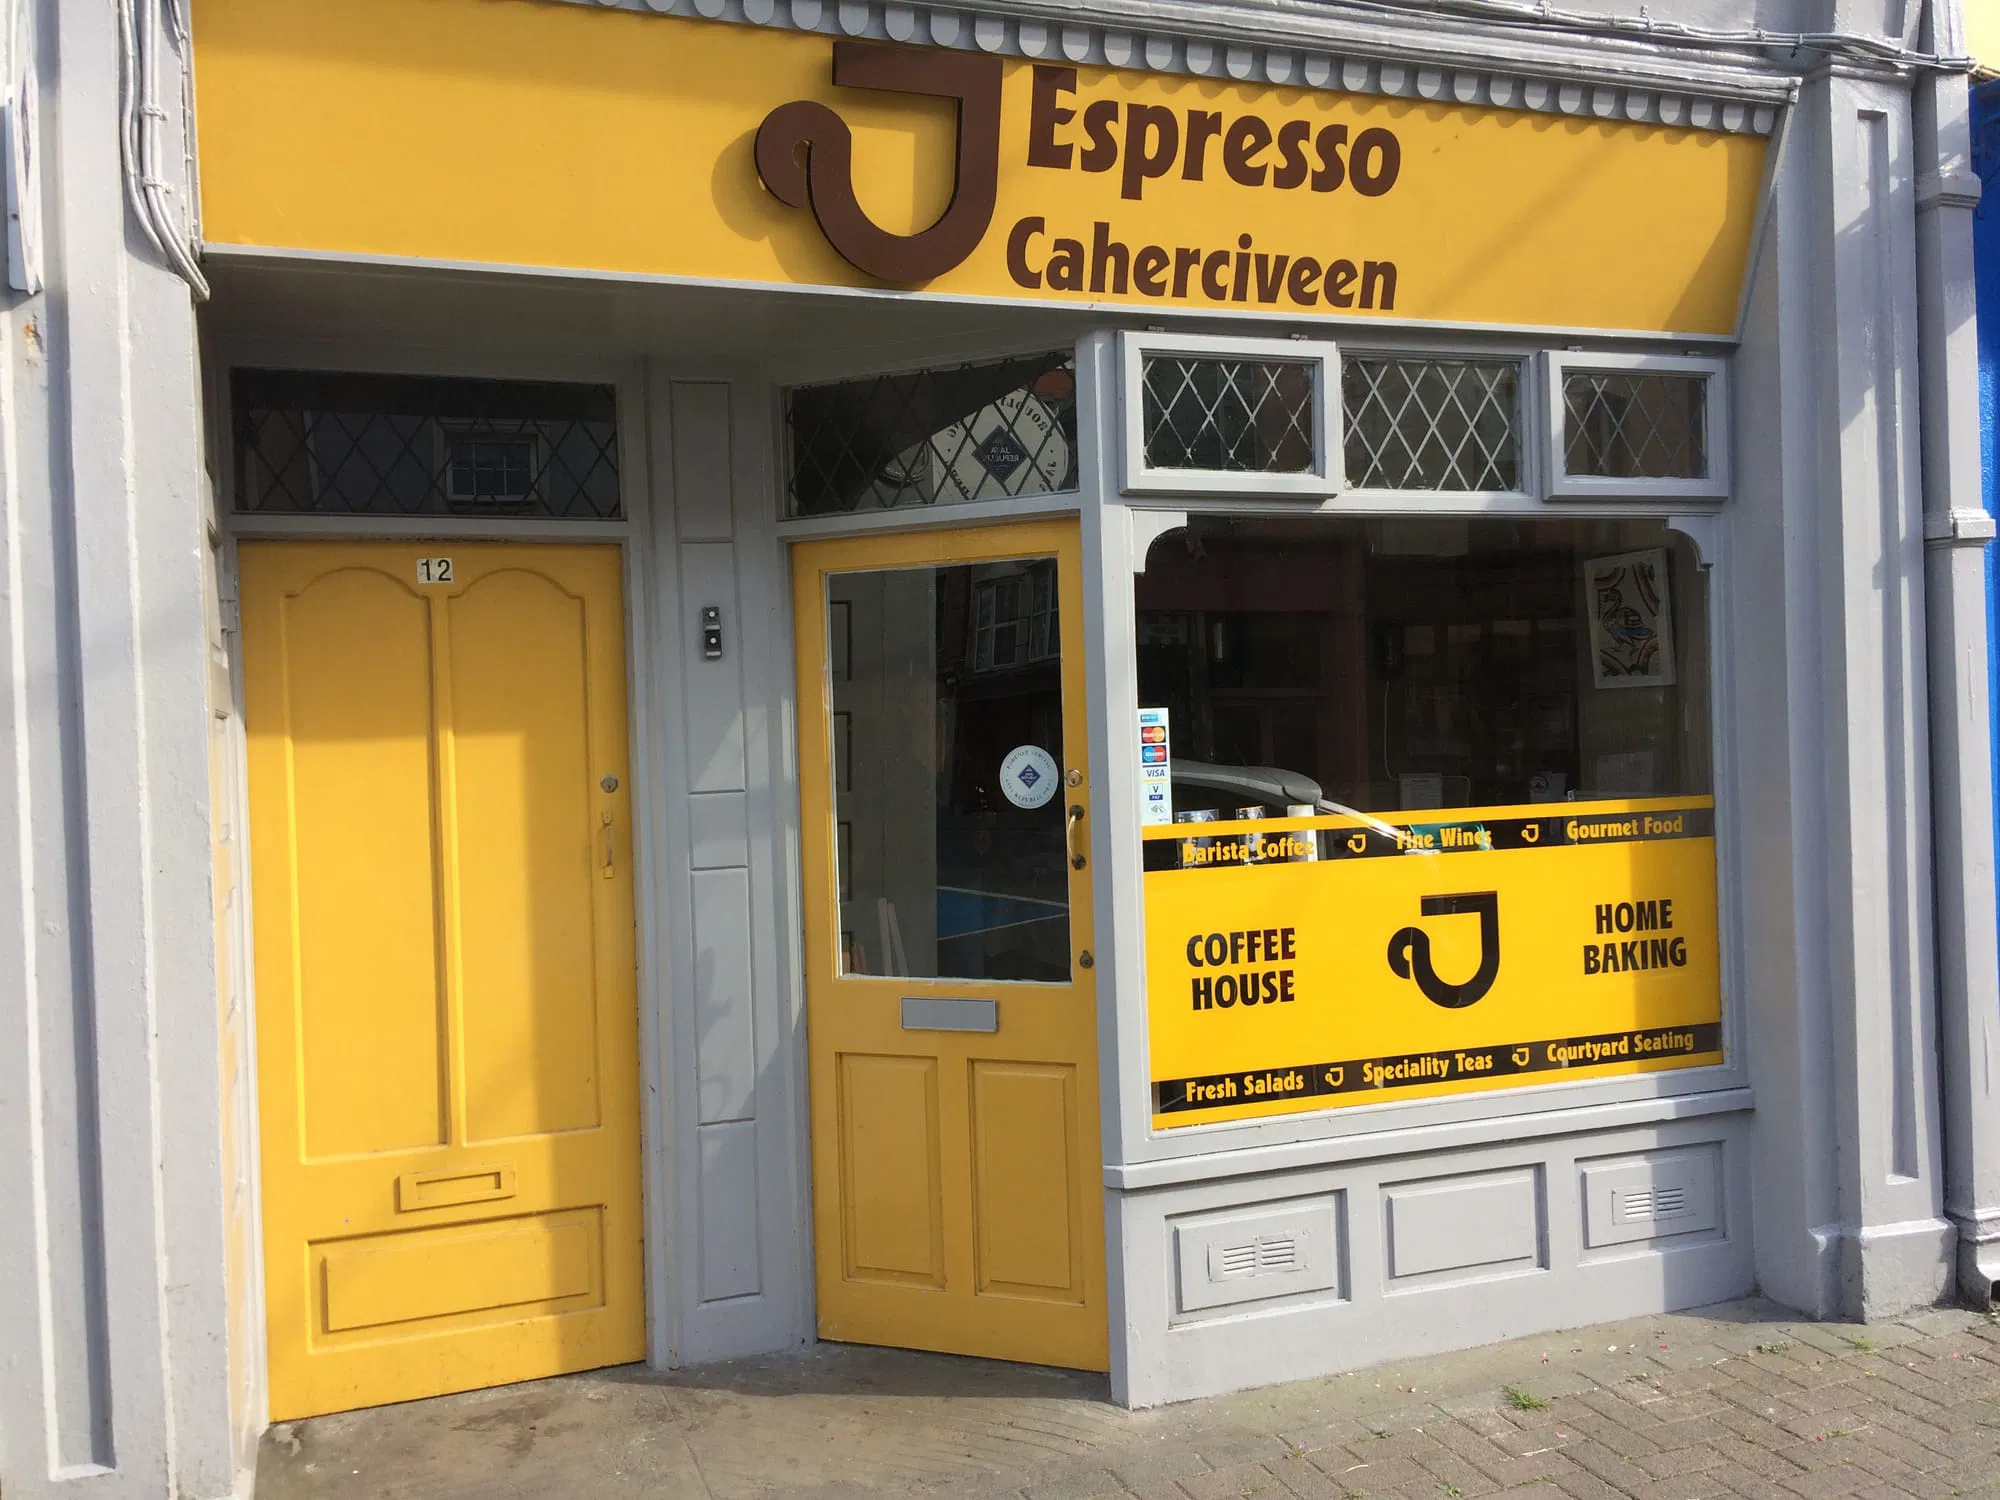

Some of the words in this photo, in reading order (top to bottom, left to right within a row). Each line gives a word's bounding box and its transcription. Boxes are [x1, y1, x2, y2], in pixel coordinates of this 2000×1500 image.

[1027, 65, 1401, 200] Espresso
[1006, 216, 1397, 311] Caherciveen
[421, 559, 451, 581] 12
[1146, 768, 1165, 777] VISA
[1182, 841, 1249, 863] Barista
[1256, 838, 1313, 859] Coffee
[1397, 830, 1433, 850] Fine
[1440, 828, 1492, 847] Wines
[1567, 818, 1639, 839] Gourmet
[1644, 816, 1683, 834] Food
[1595, 899, 1672, 934] HOME
[1186, 927, 1296, 967] COFFEE
[1583, 937, 1686, 975] BAKING
[1192, 970, 1295, 1010] HOUSE
[1186, 1078, 1237, 1102] Fresh
[1244, 1071, 1304, 1096] Salads
[1362, 1056, 1449, 1083] Speciality
[1456, 1053, 1493, 1073] Teas
[1547, 1036, 1629, 1062] Courtyard
[1634, 1031, 1694, 1052] Seating
